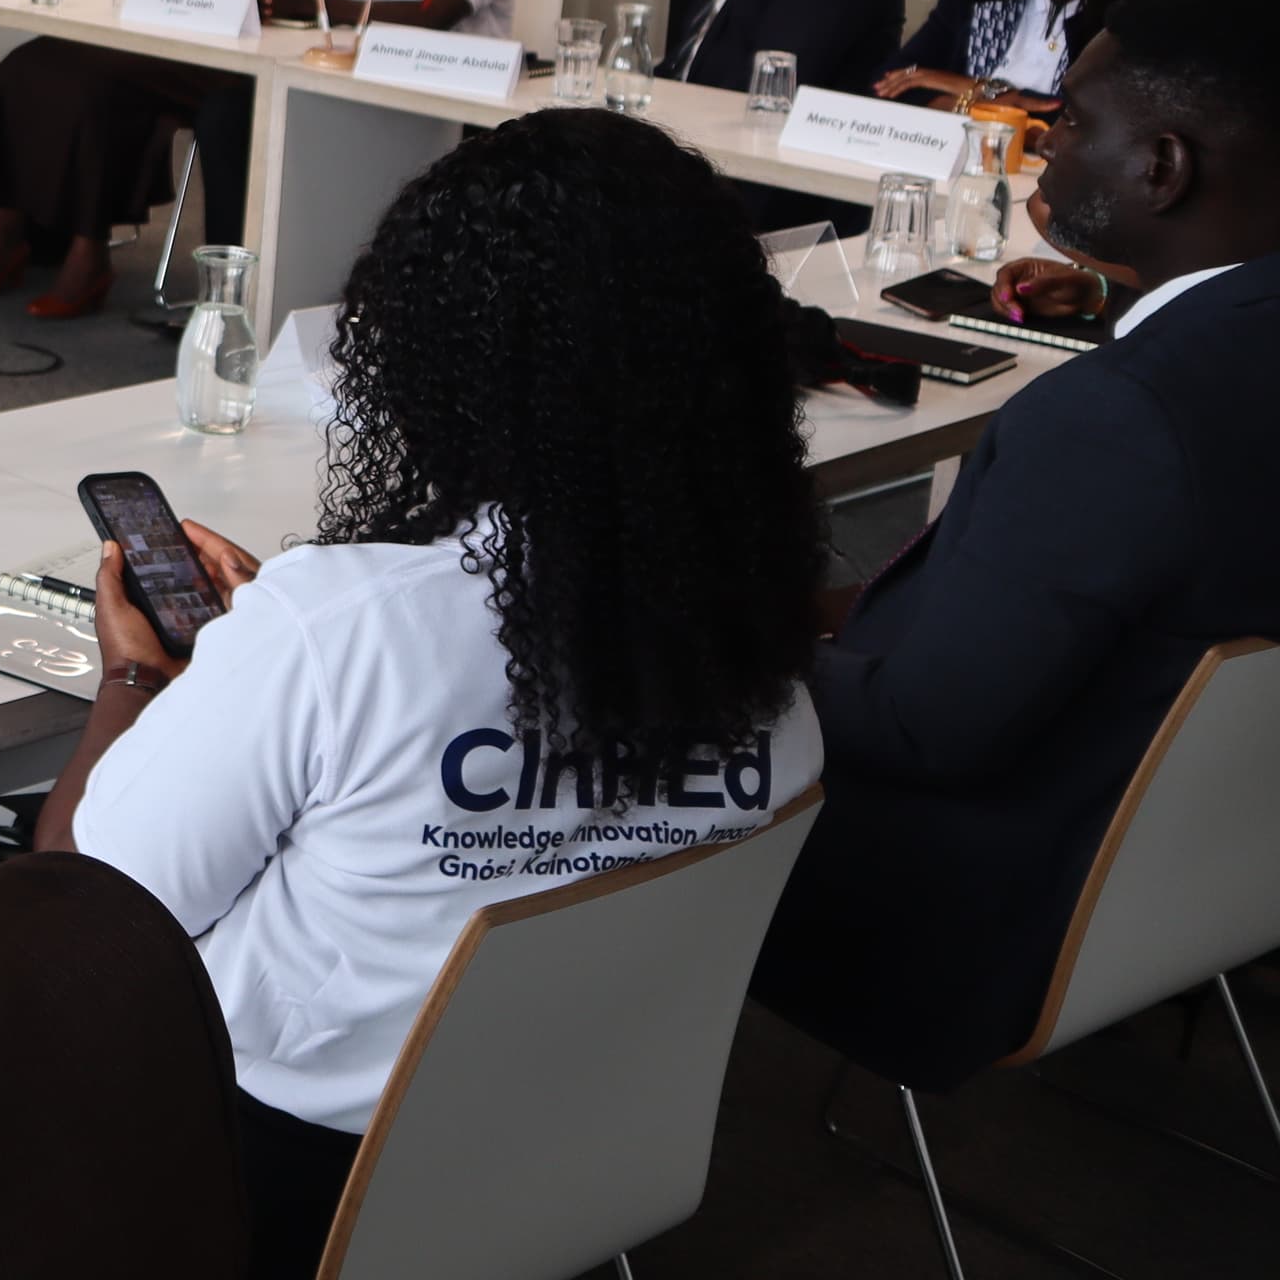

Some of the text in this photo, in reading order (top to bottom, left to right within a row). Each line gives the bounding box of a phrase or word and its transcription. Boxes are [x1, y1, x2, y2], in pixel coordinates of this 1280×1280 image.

[371, 43, 413, 58] Ahmed
[462, 55, 509, 71] Abdulai
[806, 111, 846, 130] Mercy
[888, 126, 949, 151] Tsadidey
